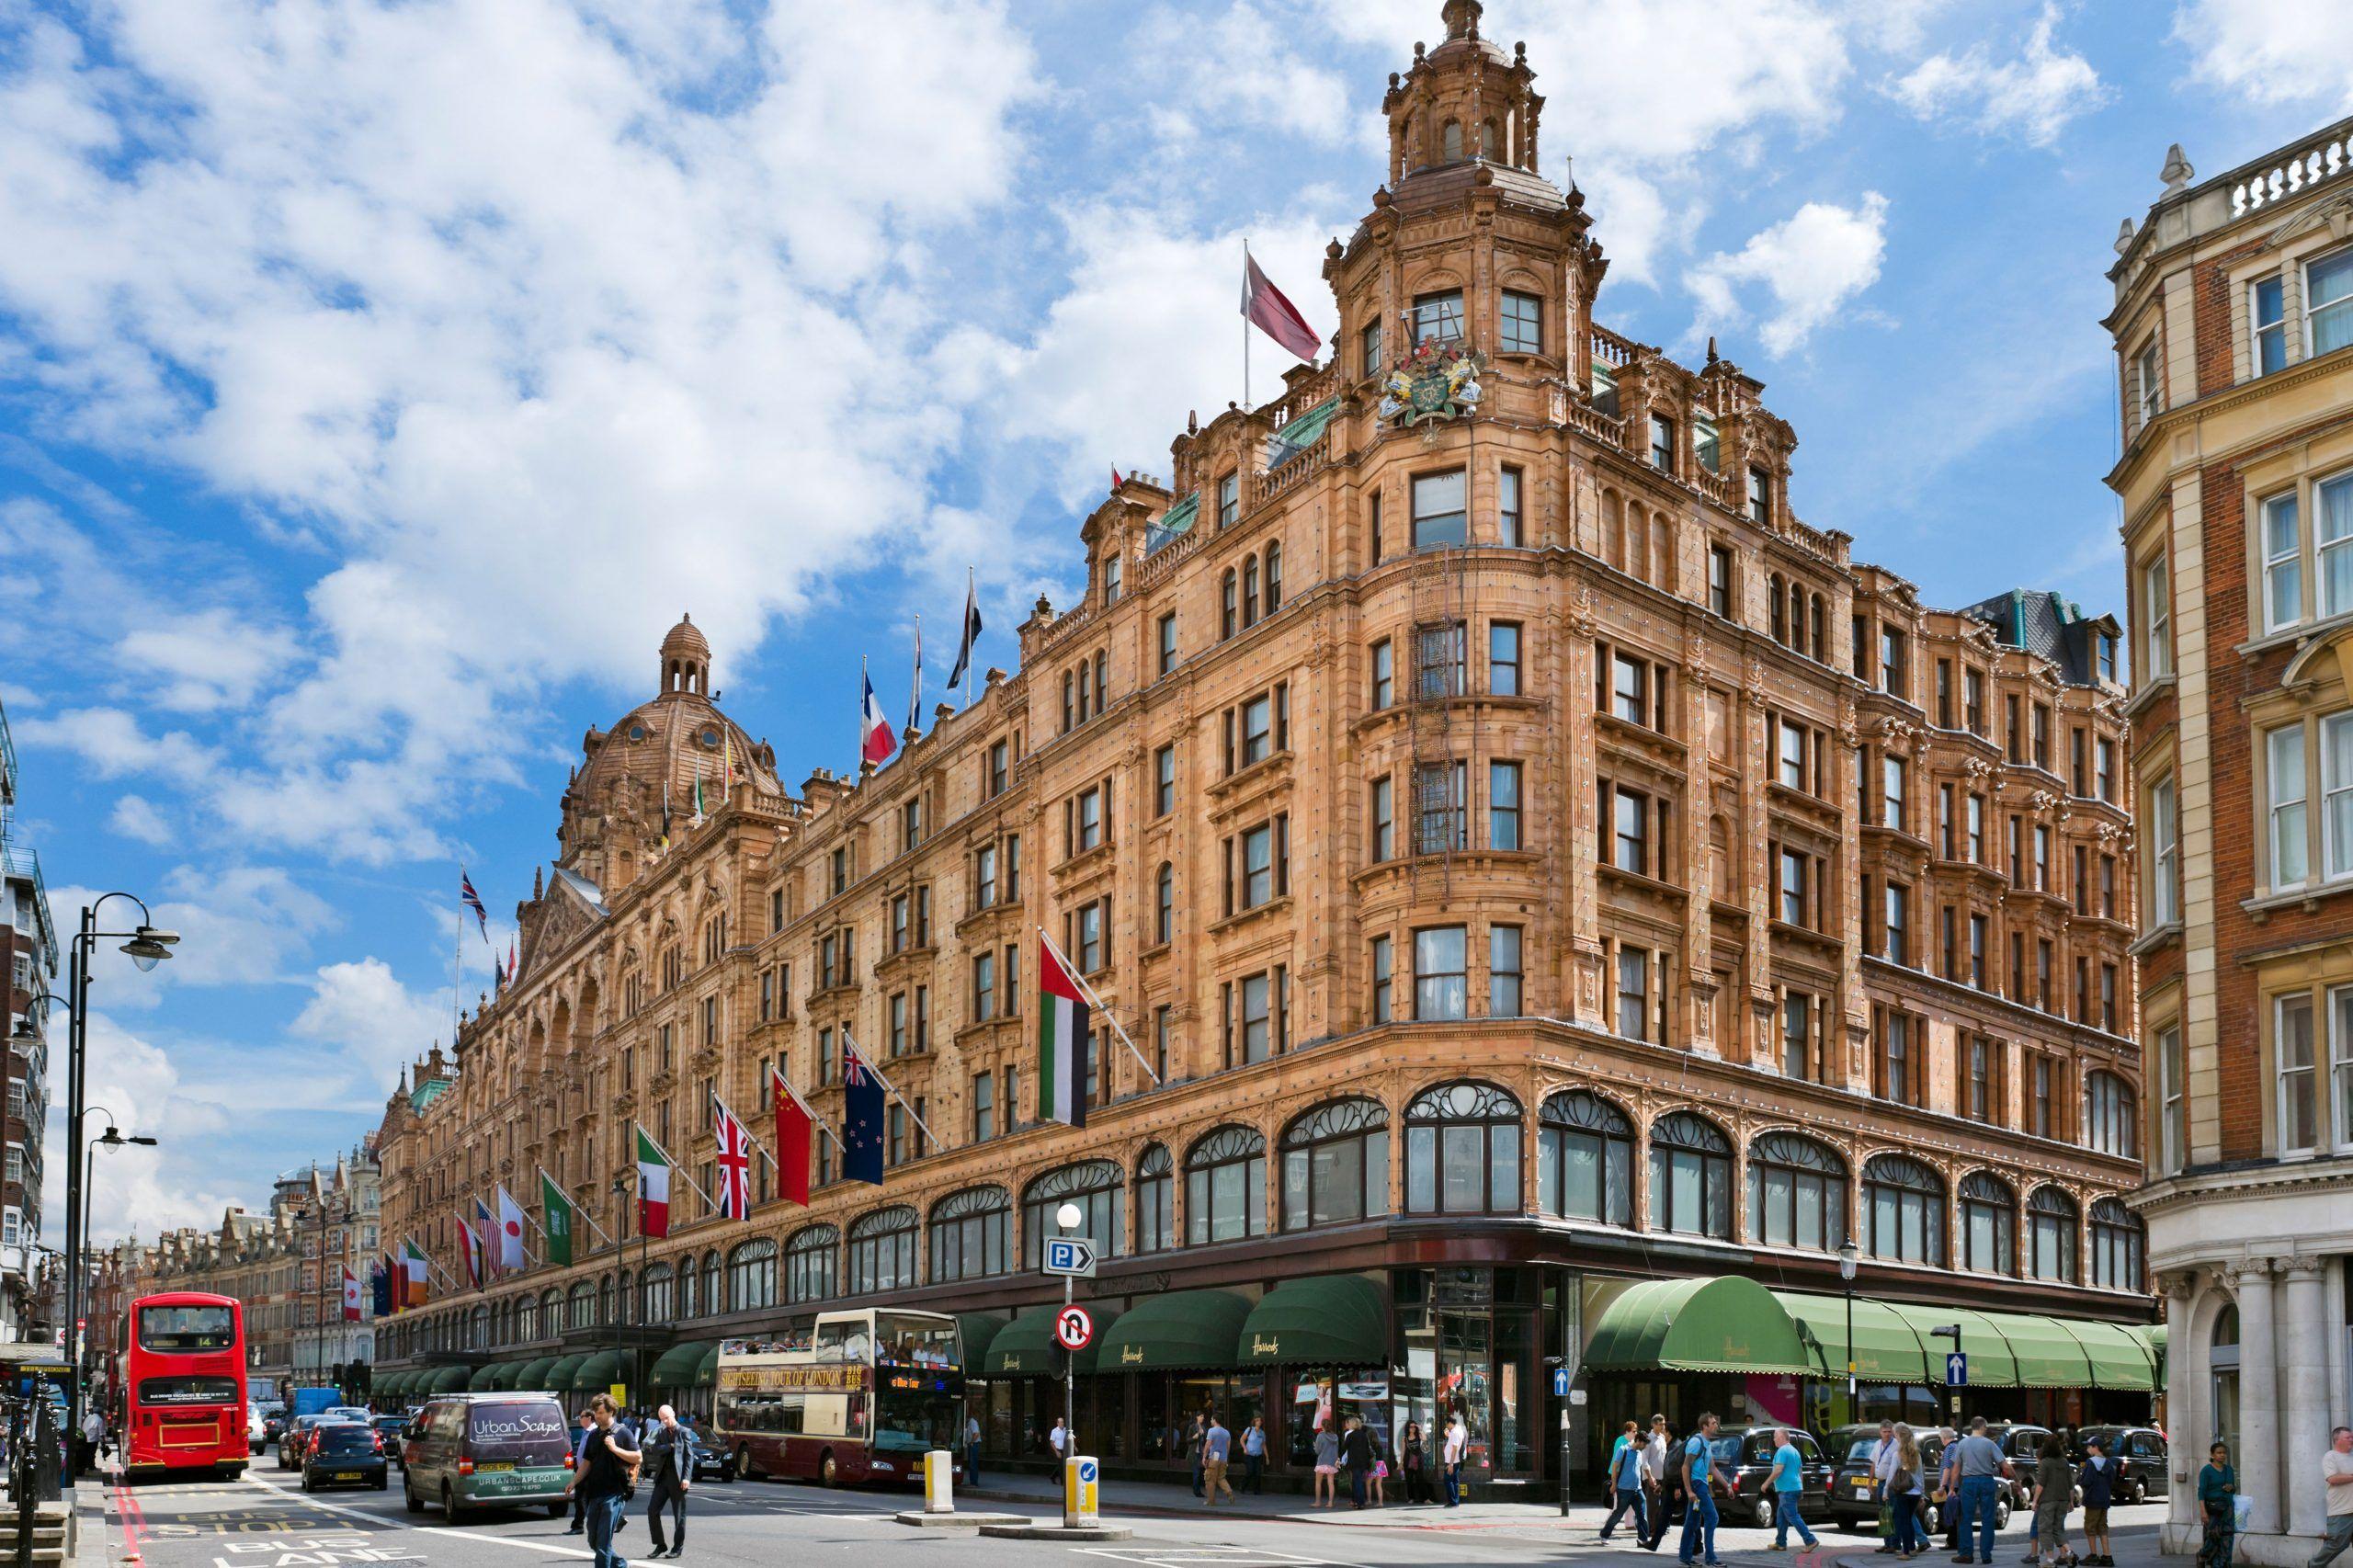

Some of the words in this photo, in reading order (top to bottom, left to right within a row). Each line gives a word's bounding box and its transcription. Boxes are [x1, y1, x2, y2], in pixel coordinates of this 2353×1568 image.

[1055, 1245, 1069, 1265] P
[199, 1337, 212, 1346] 14
[1252, 1334, 1279, 1356] Harrods
[1003, 1353, 1020, 1370] Harrods
[1120, 1344, 1143, 1364] Harrods
[722, 1371, 768, 1386] SIGHTSEEING
[770, 1371, 790, 1386] TOUR
[792, 1370, 804, 1386] OF
[805, 1369, 841, 1386] LONDON
[847, 1366, 862, 1375] BIG
[846, 1375, 861, 1384] BUS
[479, 1474, 562, 1485] URBANSCAPE.CO.UK
[156, 1521, 315, 1535] STOP
[223, 1539, 370, 1553] BUS
[212, 1547, 428, 1568] LANE
